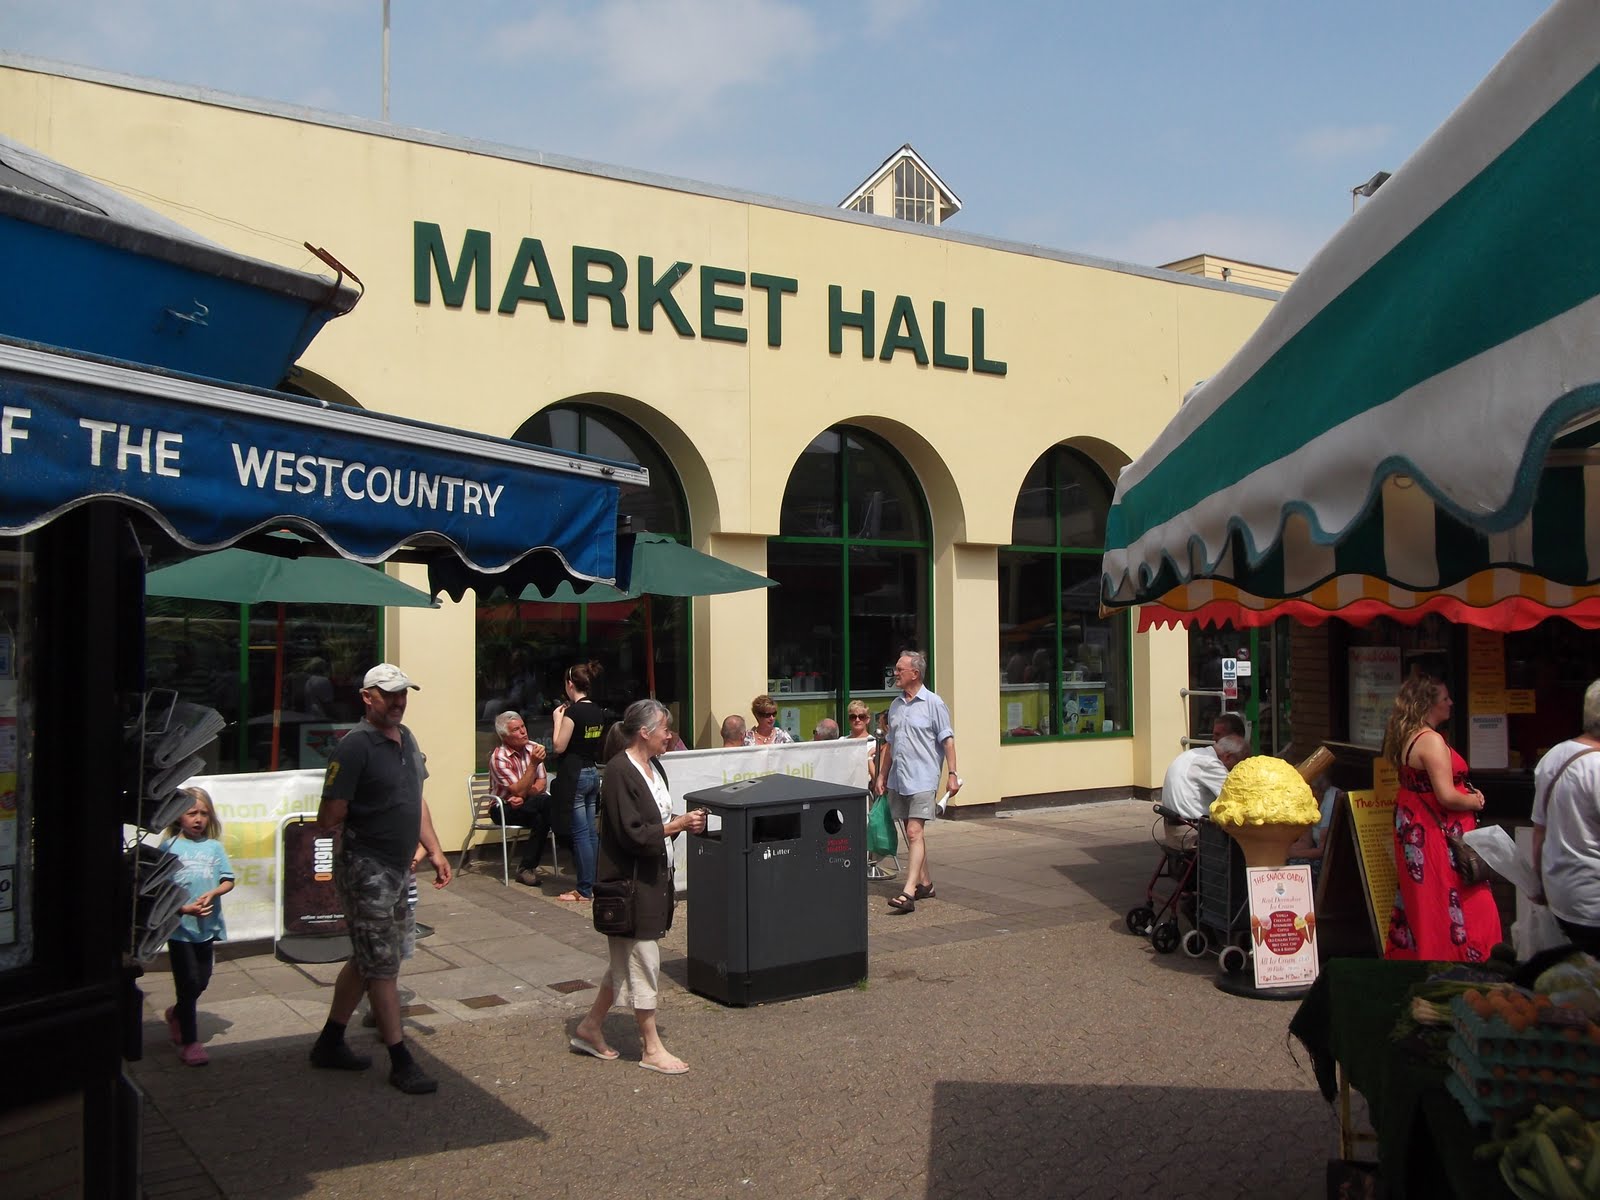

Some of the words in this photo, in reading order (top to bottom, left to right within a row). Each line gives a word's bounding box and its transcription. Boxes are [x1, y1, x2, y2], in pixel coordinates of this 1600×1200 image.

[414, 220, 798, 348] MARKET
[829, 285, 1008, 376] HALL
[79, 418, 183, 478] THE
[231, 443, 505, 518] WESTCOUNTRY
[722, 769, 777, 784] Lem
[216, 802, 267, 818] mon
[772, 848, 790, 857] Litter
[1253, 875, 1265, 885] THE
[1267, 872, 1286, 881] SNACK
[1287, 873, 1305, 884] CABIN
